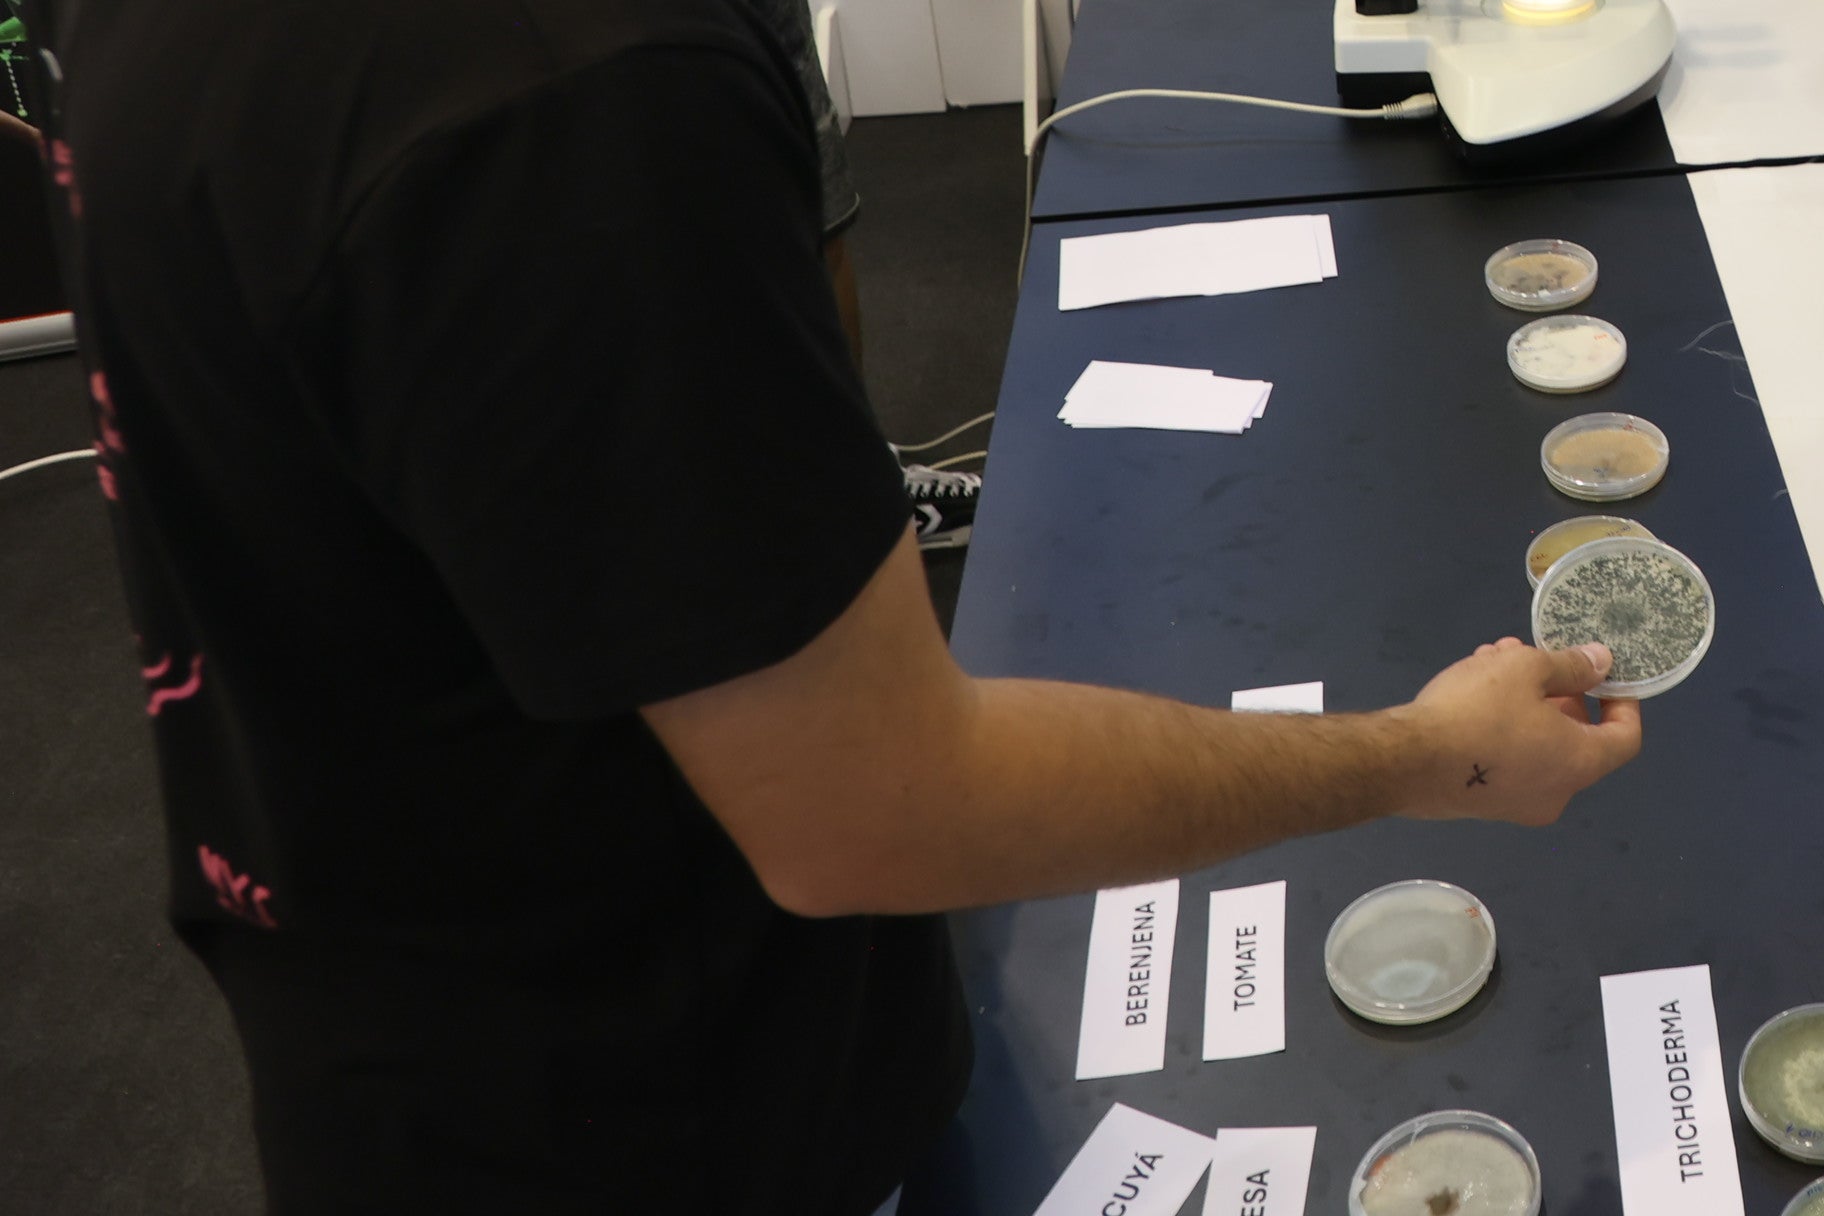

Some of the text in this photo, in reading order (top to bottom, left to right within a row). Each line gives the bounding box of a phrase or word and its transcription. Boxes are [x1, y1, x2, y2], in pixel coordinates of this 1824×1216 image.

[1125, 900, 1156, 1026] BERENJENA
[1233, 925, 1257, 1012] TOMATE
[1659, 998, 1704, 1184] TRICHODERMA
